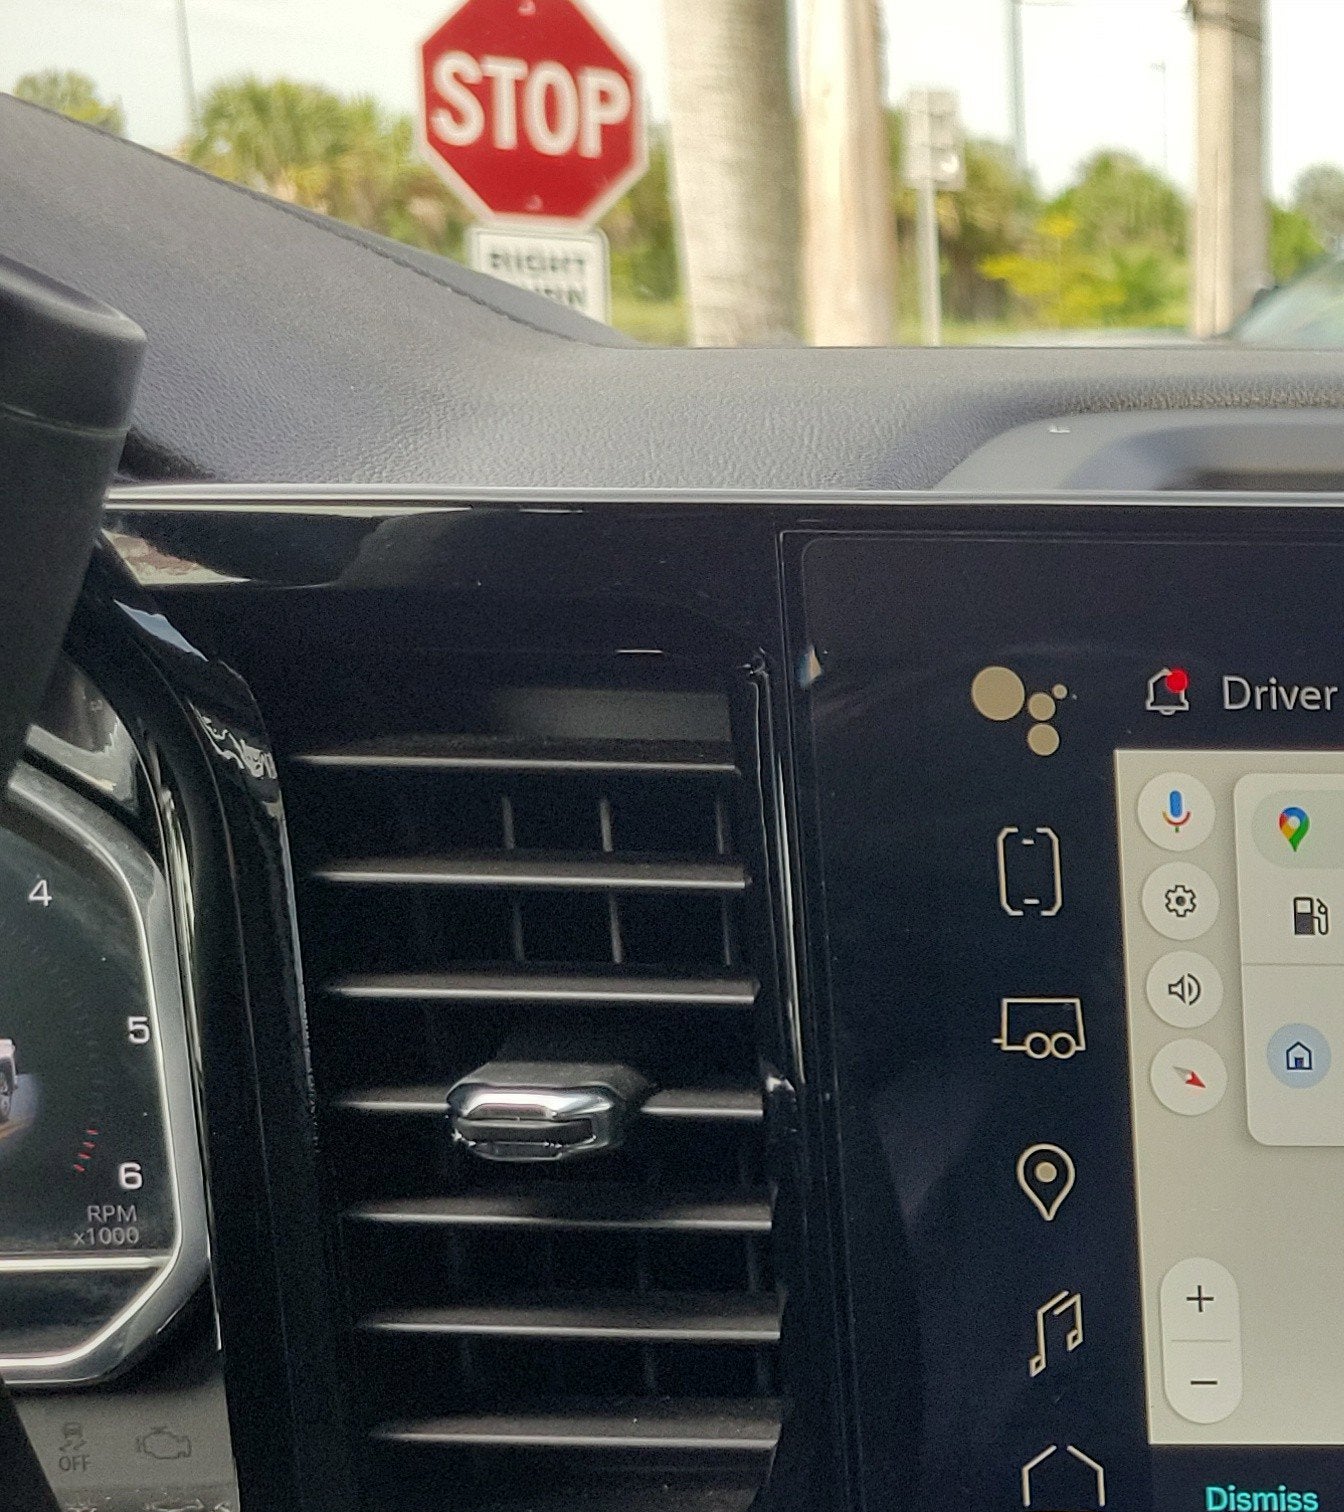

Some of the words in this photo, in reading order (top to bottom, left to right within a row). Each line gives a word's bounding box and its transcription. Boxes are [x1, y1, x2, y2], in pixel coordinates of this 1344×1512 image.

[431, 51, 631, 157] STOP
[1222, 675, 1338, 711] Driver
[28, 880, 53, 906] 4
[127, 1016, 151, 1044] 5
[118, 1162, 143, 1190] 6
[87, 1204, 138, 1223] RPM
[73, 1226, 140, 1246] x1000
[58, 1455, 91, 1472] OFF
[1205, 1484, 1319, 1512] Dismiss
